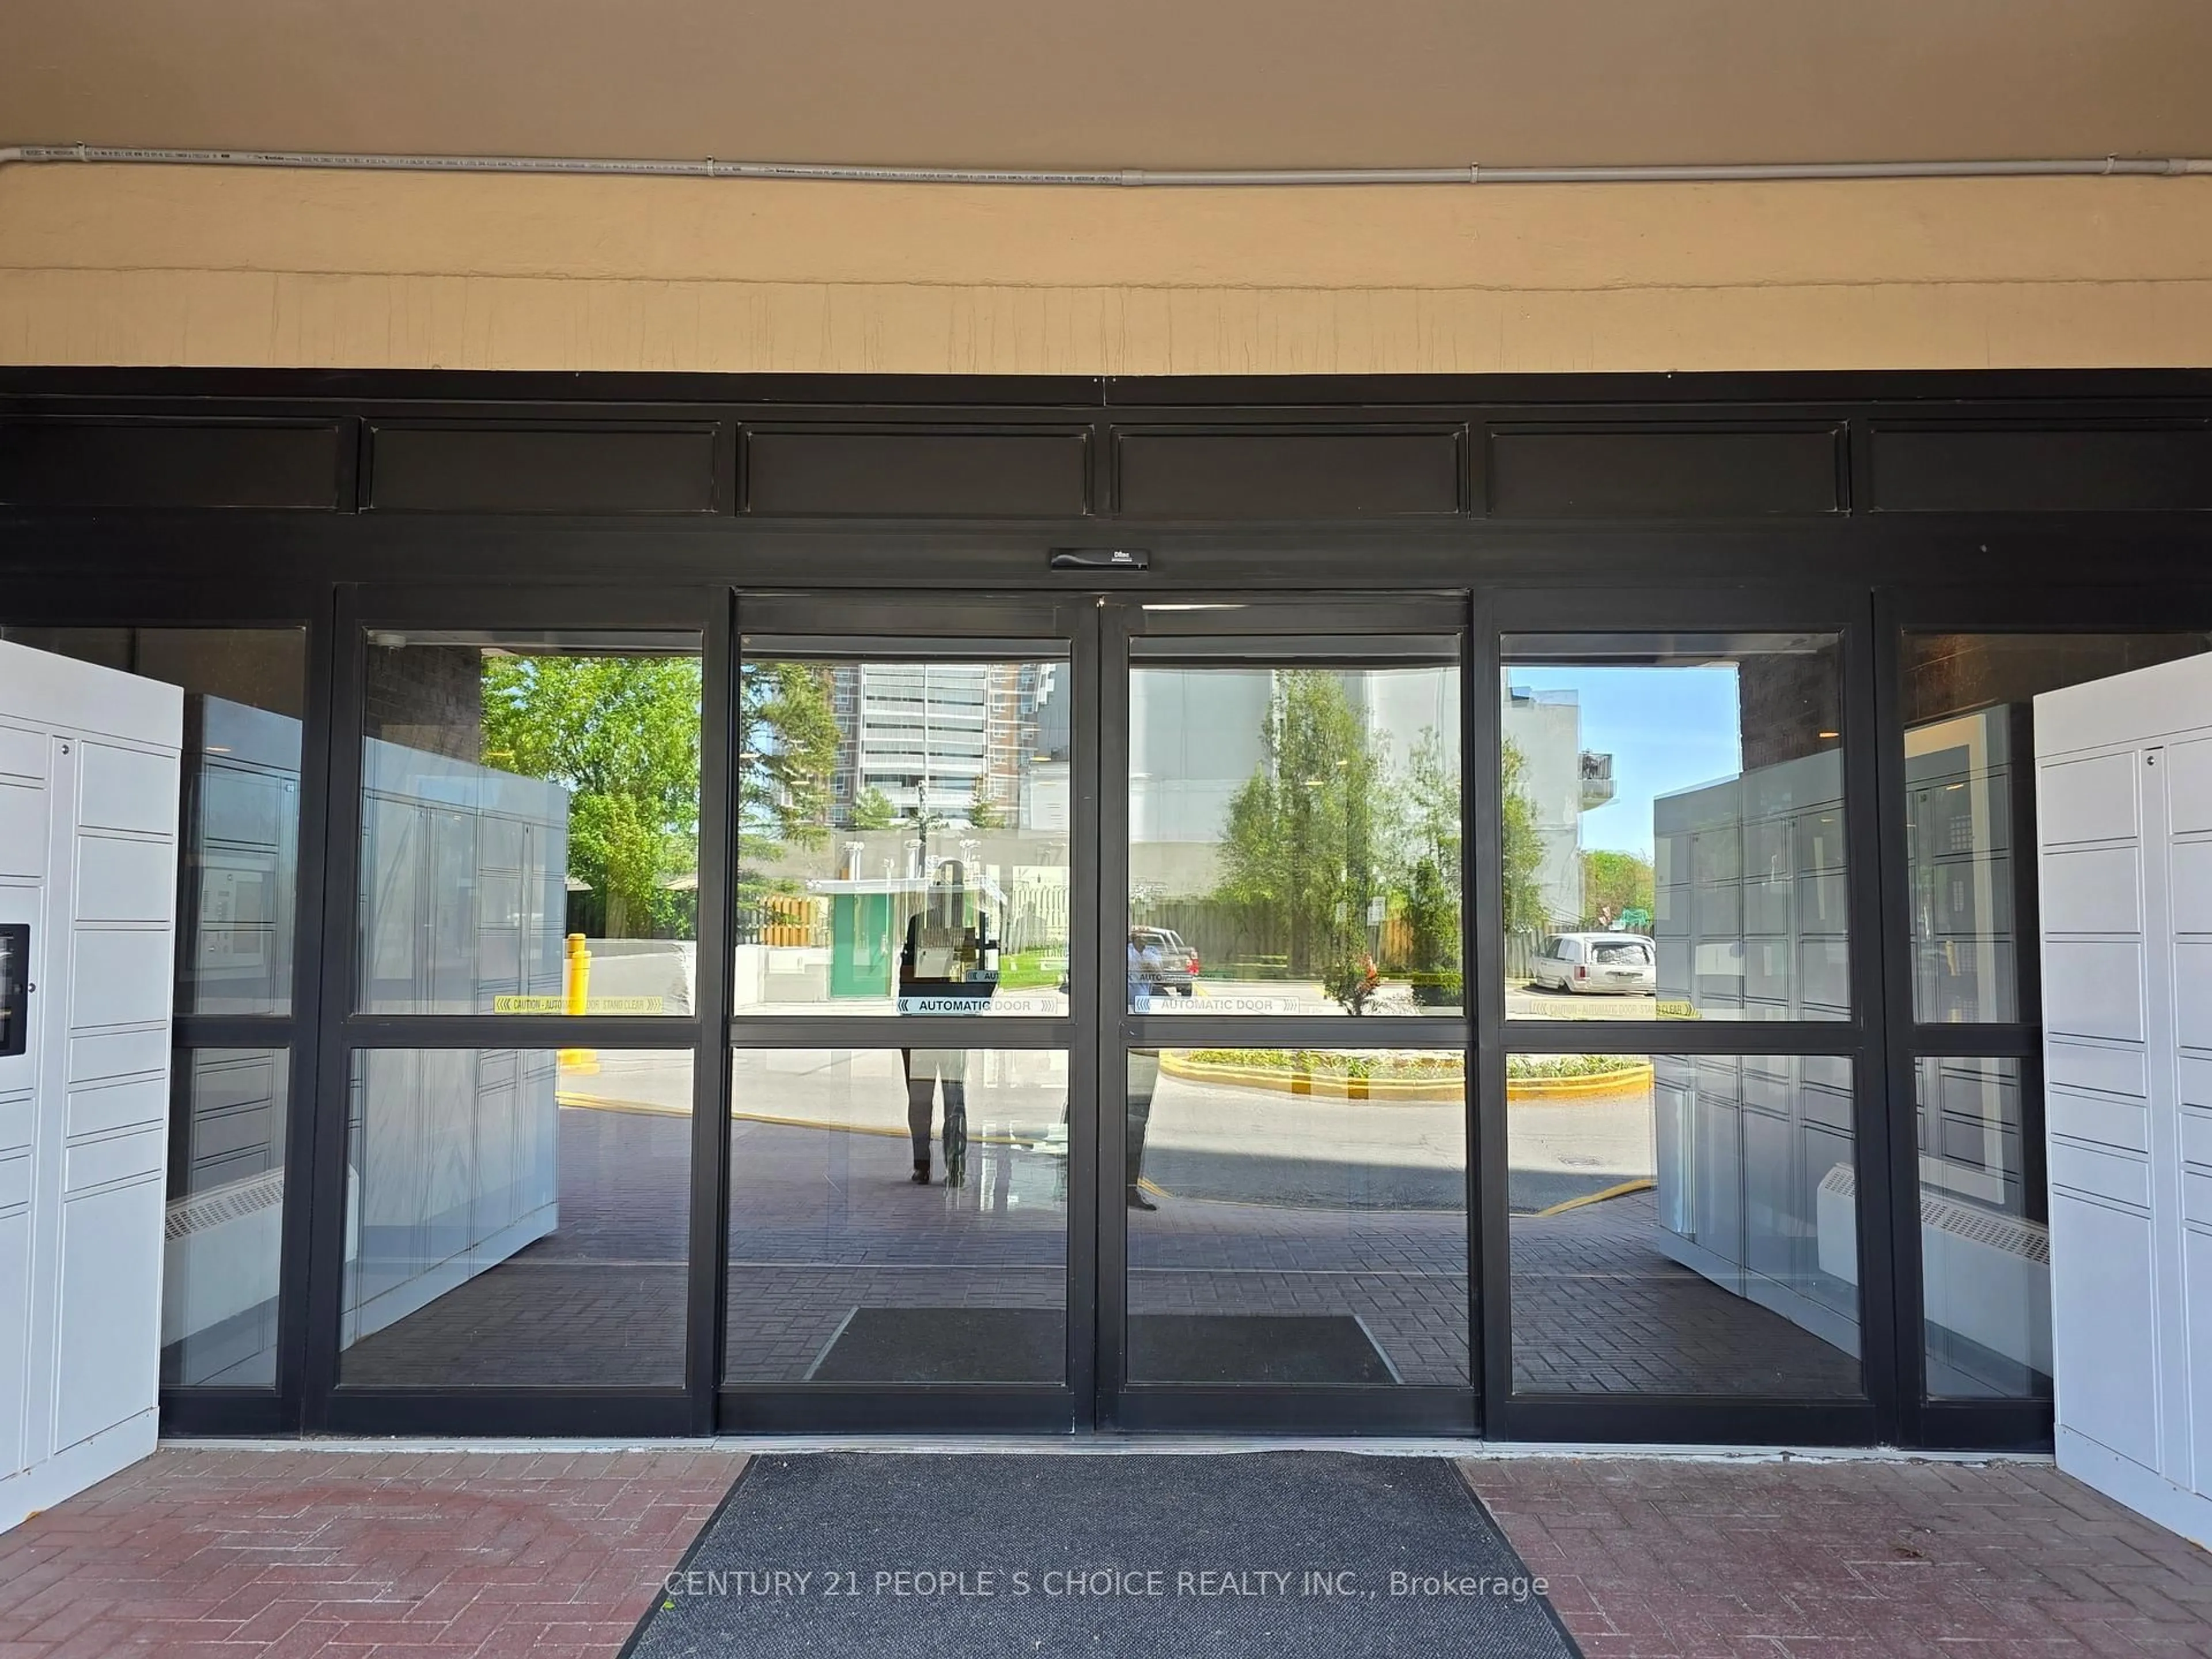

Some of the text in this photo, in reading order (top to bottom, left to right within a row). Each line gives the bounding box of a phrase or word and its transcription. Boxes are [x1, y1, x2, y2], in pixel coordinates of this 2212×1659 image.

[513, 999, 540, 1010] CAUTION
[919, 1001, 1031, 1010] AUTOMATIC DOOR
[1161, 999, 1273, 1010] AUTOMATIC DOOR
